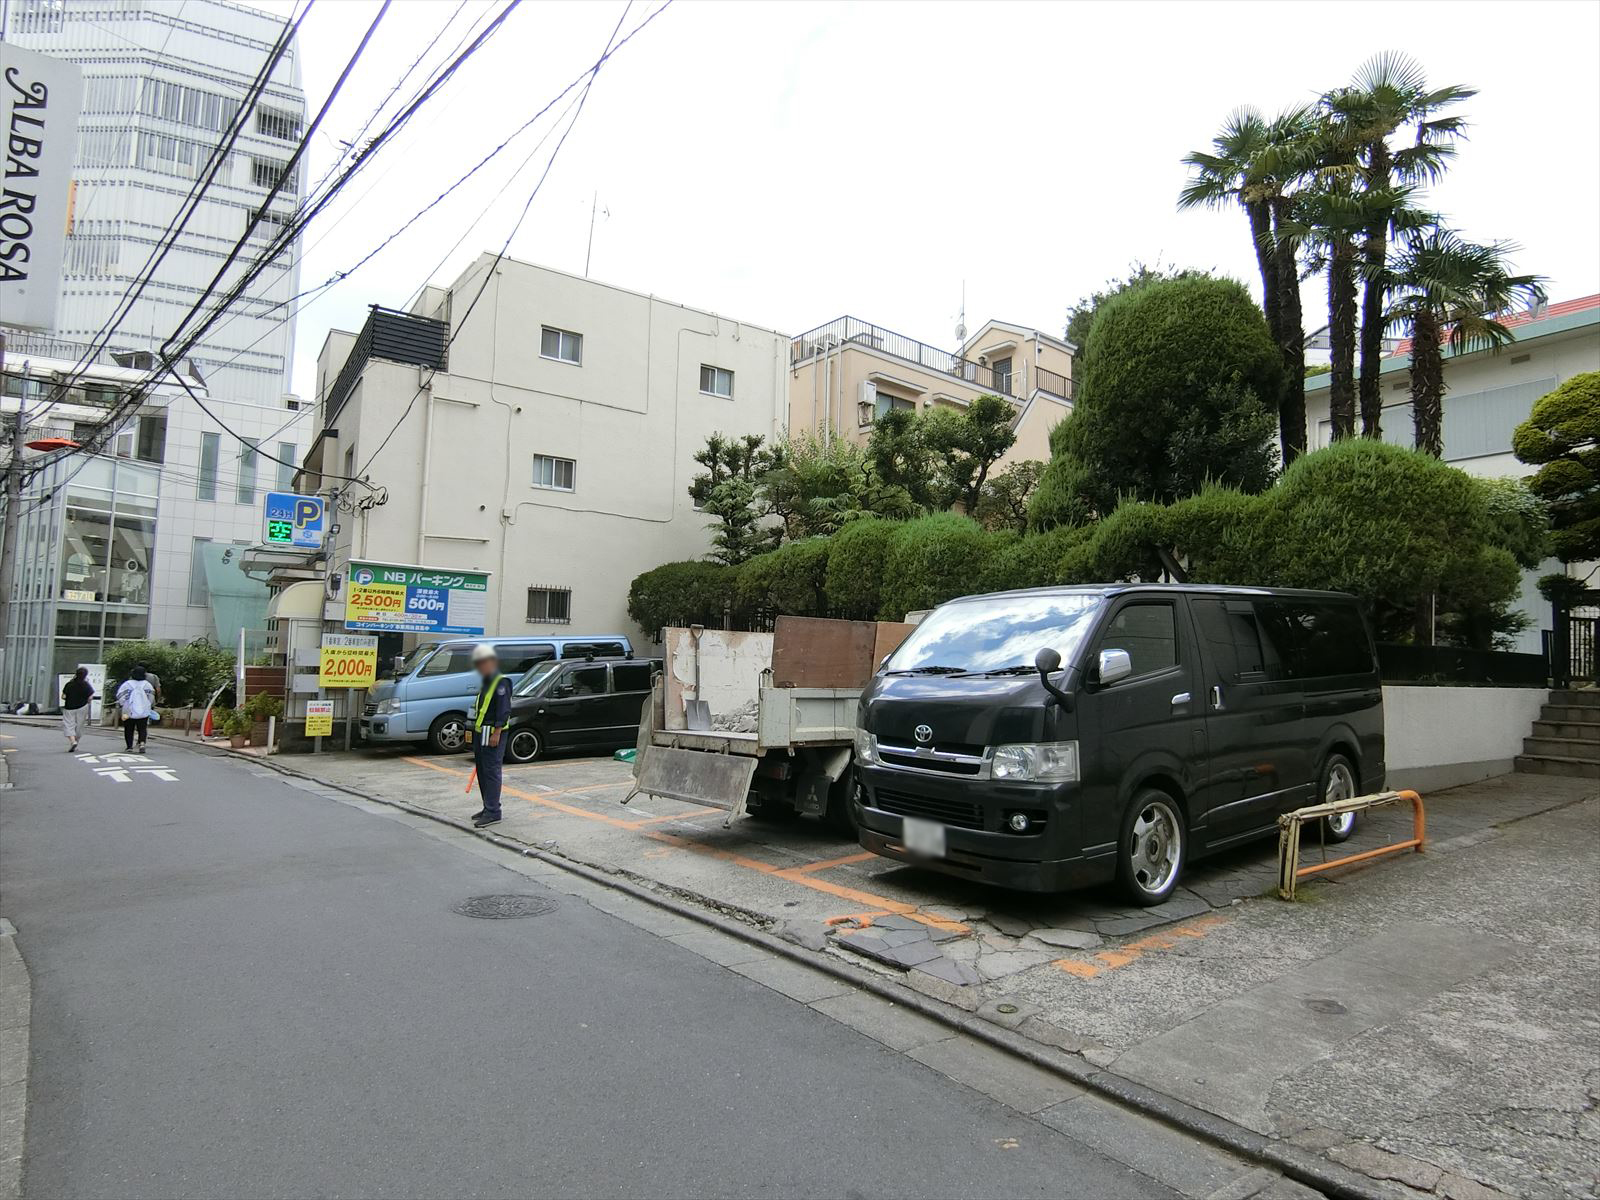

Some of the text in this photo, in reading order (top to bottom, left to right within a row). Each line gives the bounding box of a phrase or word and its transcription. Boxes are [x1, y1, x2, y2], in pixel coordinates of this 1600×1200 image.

[0, 66, 48, 282] ALBA ROSA
[271, 507, 294, 519] 24H
[295, 499, 321, 529] P
[269, 521, 292, 542] 空
[384, 571, 465, 587] NB パーキング
[351, 594, 401, 608] 2,500円
[409, 598, 445, 611] 500円
[324, 658, 372, 677] 2,000円
